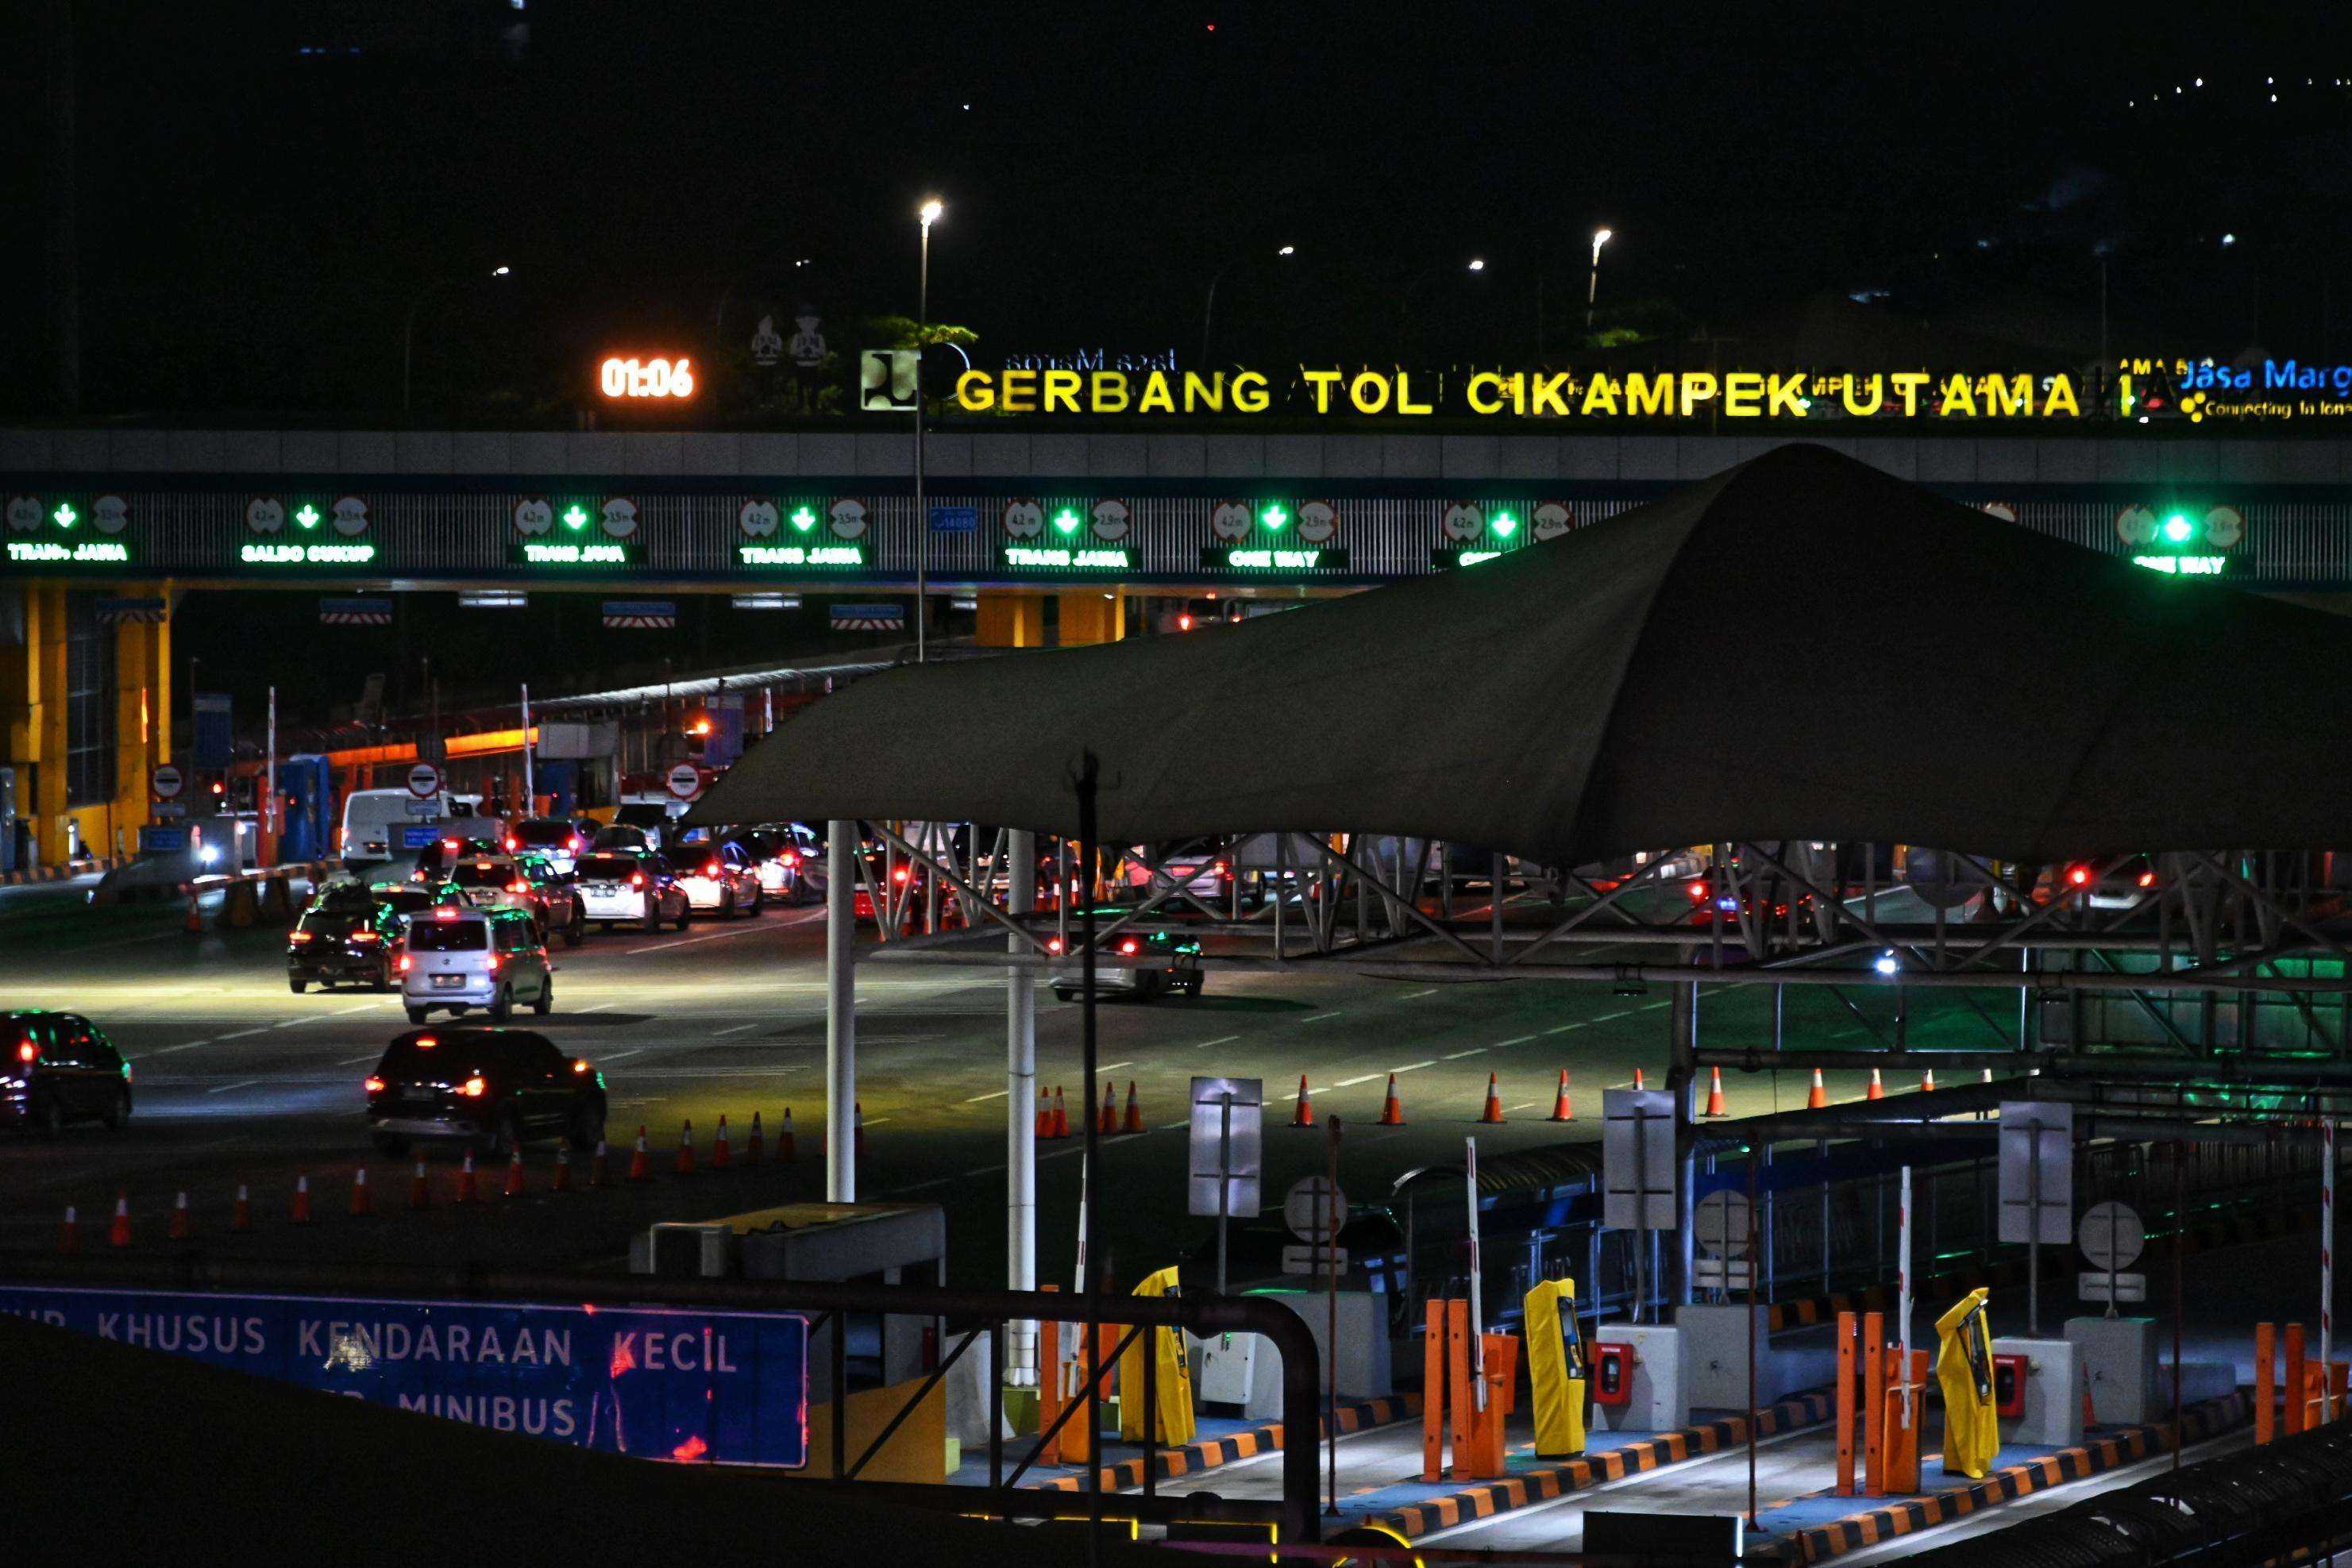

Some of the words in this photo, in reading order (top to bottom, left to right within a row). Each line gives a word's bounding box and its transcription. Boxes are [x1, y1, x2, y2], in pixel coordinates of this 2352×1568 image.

[602, 359, 694, 397] 01:06
[2180, 360, 2252, 389] Jasa
[955, 369, 1270, 413] GERBANG
[1303, 371, 1433, 414] TOL
[1467, 372, 1808, 417] CIKAMPEK
[1842, 373, 2080, 418] UTAMA
[241, 545, 306, 562] SALDO
[524, 545, 580, 562] TRANS
[739, 547, 805, 564] TRANS
[806, 547, 862, 564] JAWA
[1005, 549, 1070, 566] TRANS
[1072, 549, 1128, 567] JAWA
[1228, 550, 1271, 568] ONE
[1273, 550, 1319, 568] WAY
[2179, 556, 2226, 575] WAY
[97, 1312, 268, 1355] KHUSUS
[298, 1319, 573, 1366] KENDARAAN
[612, 1330, 738, 1373] KECIL
[397, 1393, 576, 1437] MINIBUS
